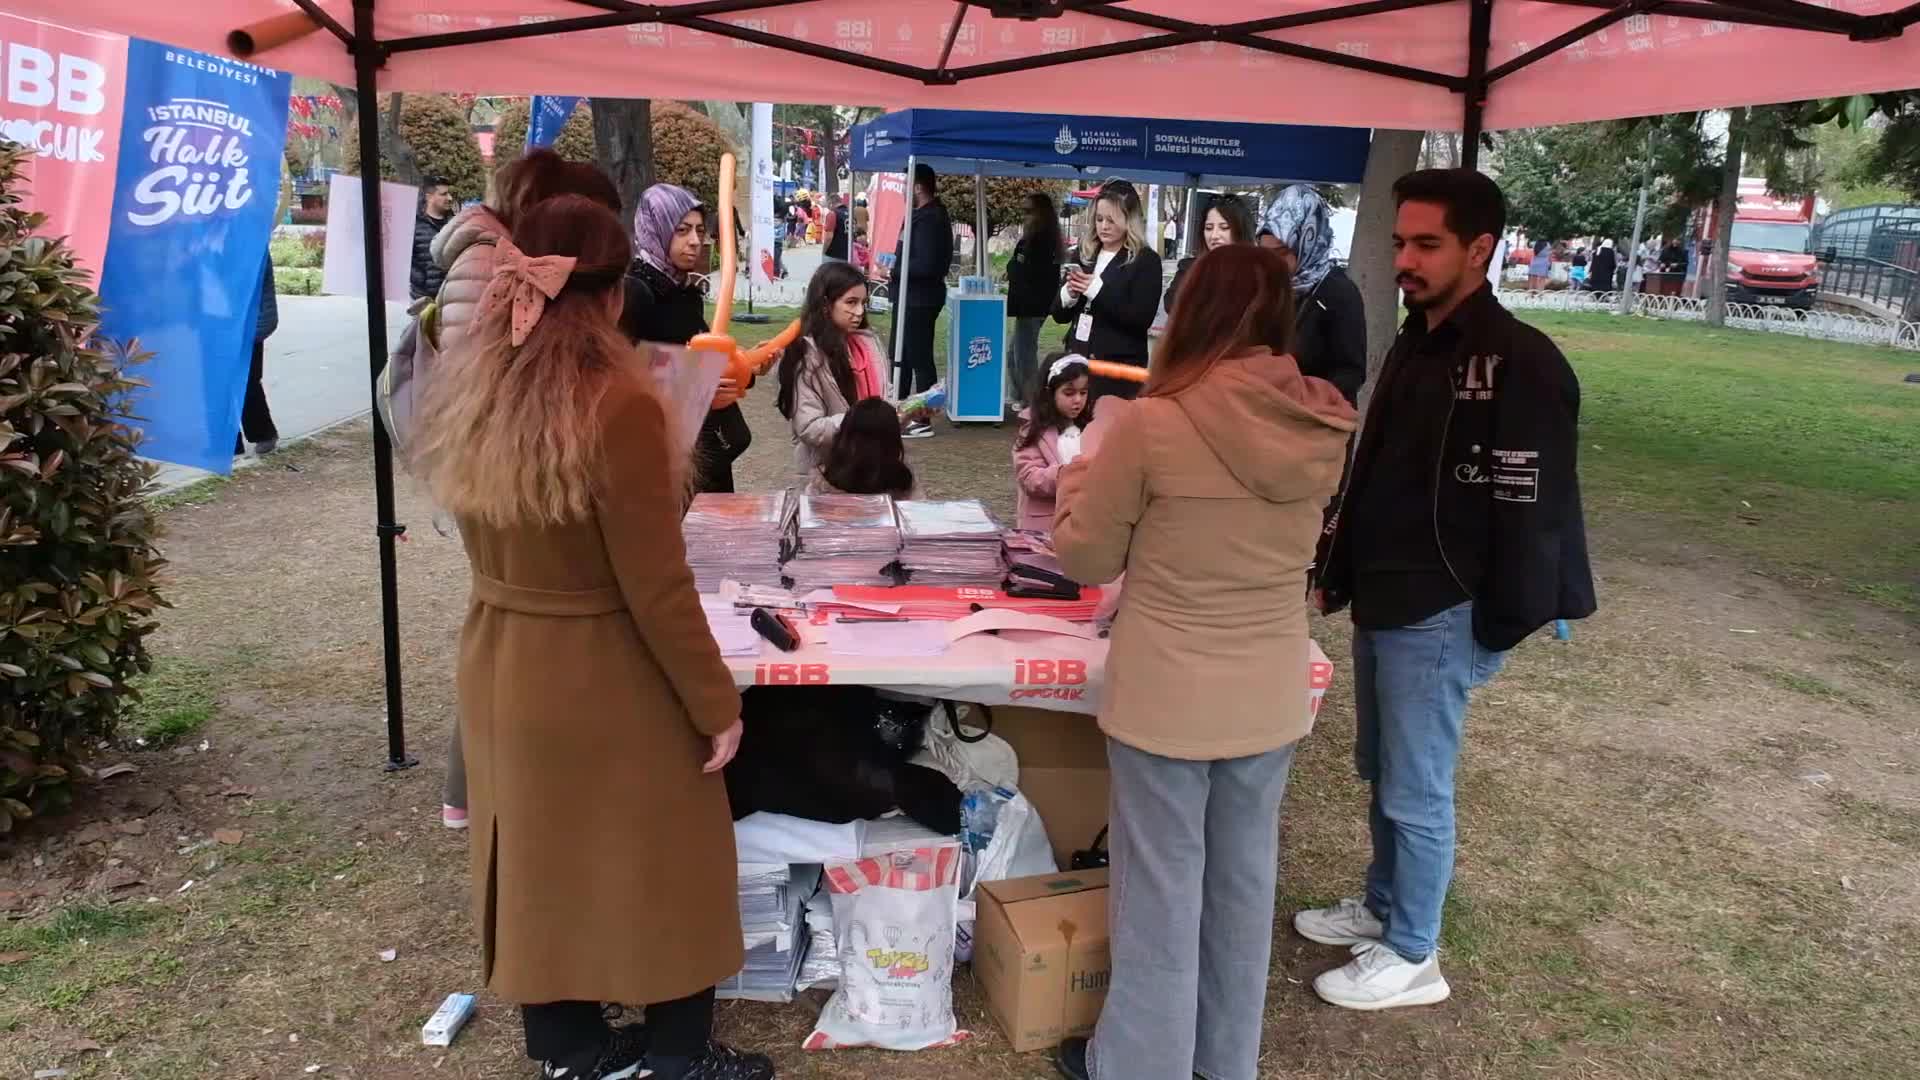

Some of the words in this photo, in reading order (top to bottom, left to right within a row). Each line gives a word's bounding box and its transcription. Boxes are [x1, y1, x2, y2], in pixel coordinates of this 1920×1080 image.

[0, 42, 105, 116] BB
[143, 126, 249, 168] Halk
[1154, 134, 1190, 144] SOSYAL
[1191, 135, 1241, 147] HİZMETLER
[1154, 144, 1190, 154] DAİRESİ
[1191, 146, 1245, 157] BAŞKANLIĞI
[127, 164, 253, 226] Süt
